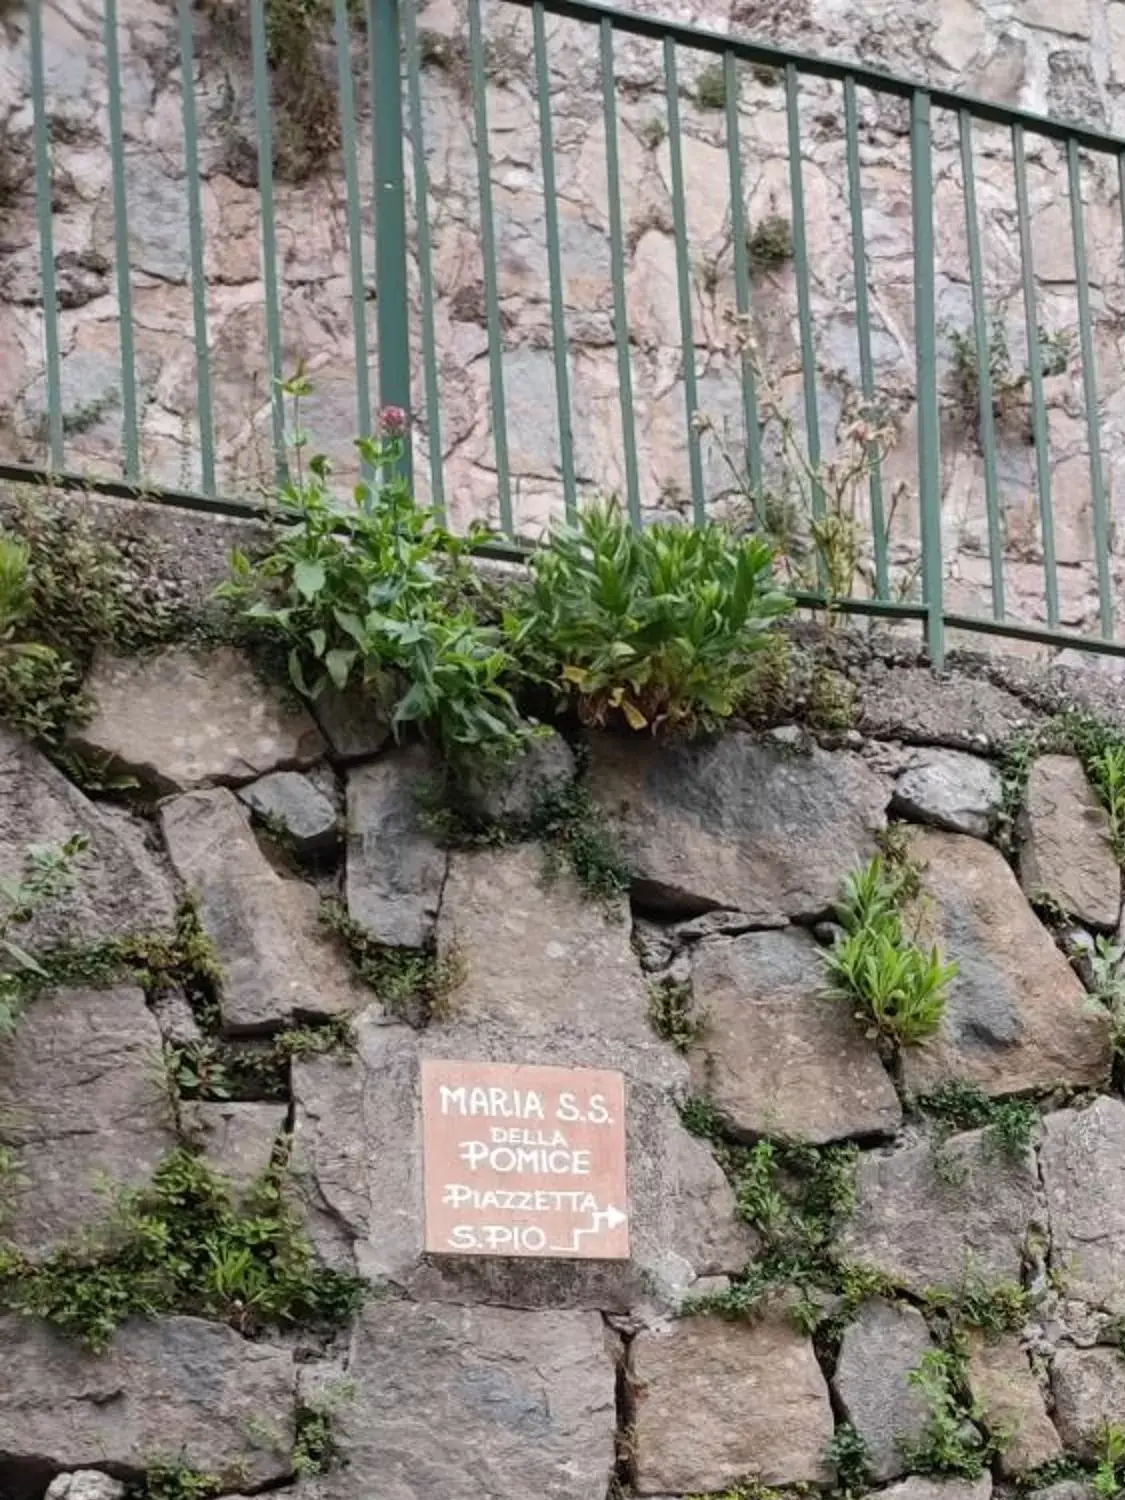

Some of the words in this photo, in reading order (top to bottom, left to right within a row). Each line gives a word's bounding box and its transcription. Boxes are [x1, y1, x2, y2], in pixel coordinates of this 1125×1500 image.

[439, 1085, 545, 1119] MARIA
[555, 1092, 615, 1124] S.S.
[490, 1127, 568, 1147] DELLA
[458, 1140, 592, 1175] POMICE
[442, 1183, 598, 1212] PIAZZETTA
